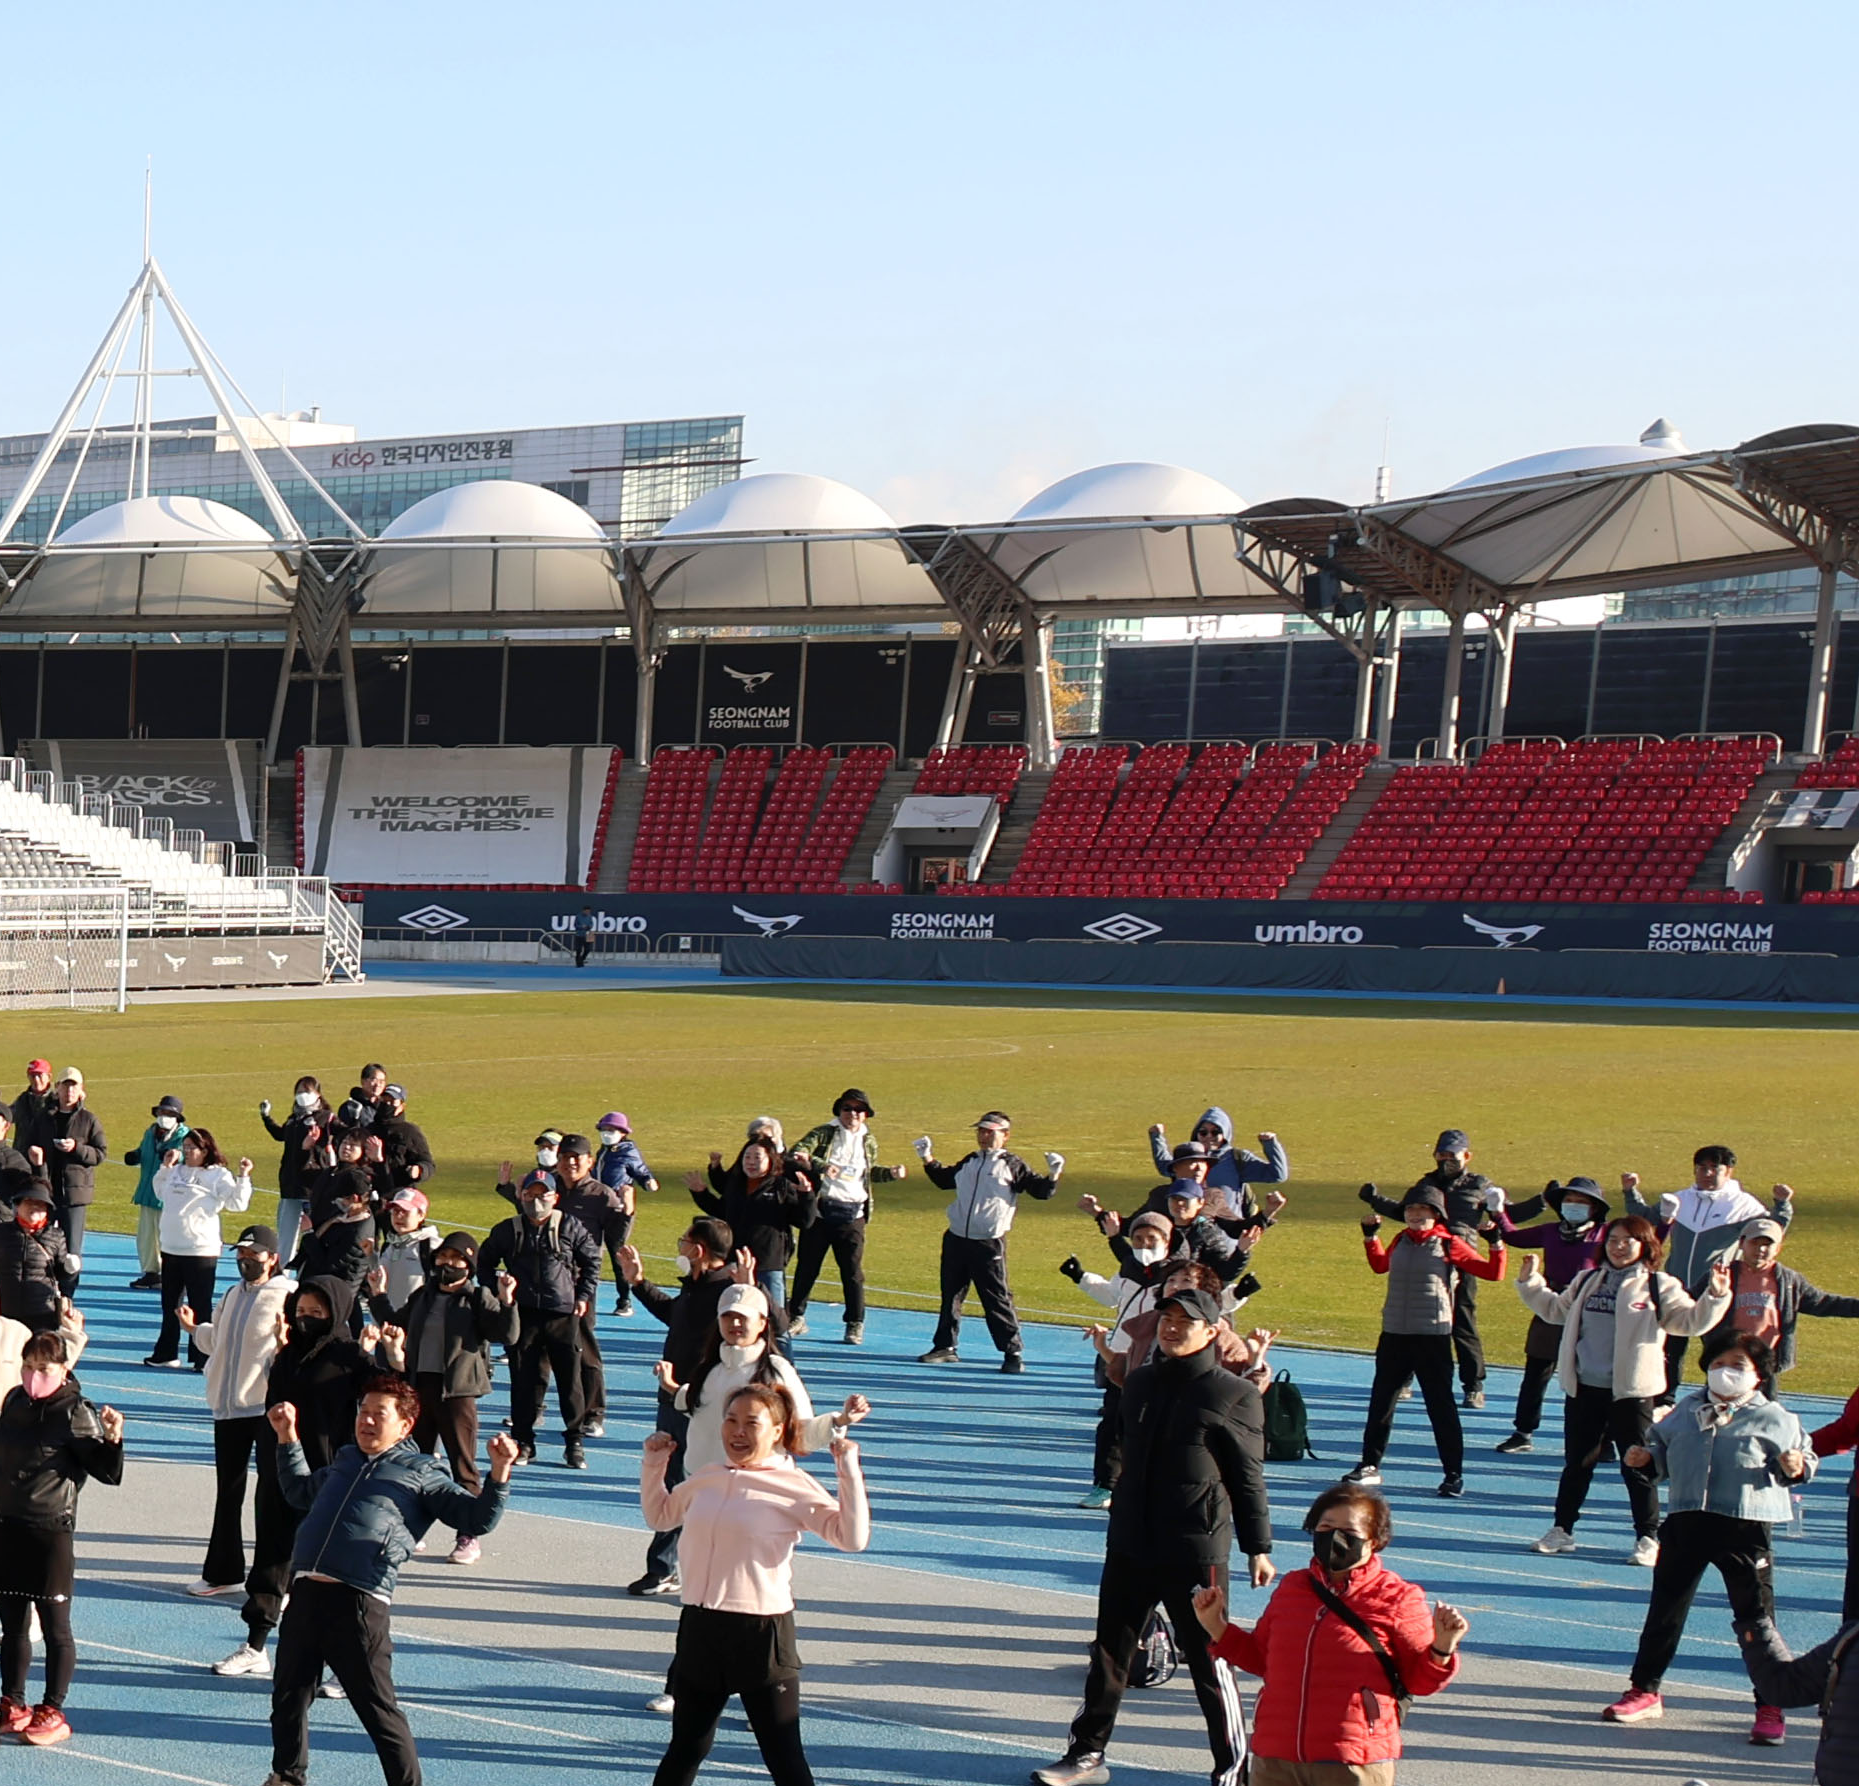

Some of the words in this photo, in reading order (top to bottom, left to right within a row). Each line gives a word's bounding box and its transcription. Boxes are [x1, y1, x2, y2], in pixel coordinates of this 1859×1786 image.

[382, 438, 513, 467] 한국디자인진흥원
[708, 706, 791, 719] SEONGNAM
[708, 719, 761, 729] FOOTBALL
[763, 719, 790, 728] CLUB
[371, 795, 531, 807] WELCOME
[347, 808, 410, 820] THE
[459, 807, 555, 819] HOME
[379, 820, 531, 832] MAGPIES.
[891, 912, 994, 928] SEONGNAM
[890, 928, 955, 939] FOOTBALL
[960, 928, 993, 939] CLUB
[1255, 919, 1363, 945] umbro
[1648, 922, 1774, 940] SEONGNAM
[1647, 939, 1726, 953] FOOTBALL
[1731, 939, 1771, 953] CLUB
